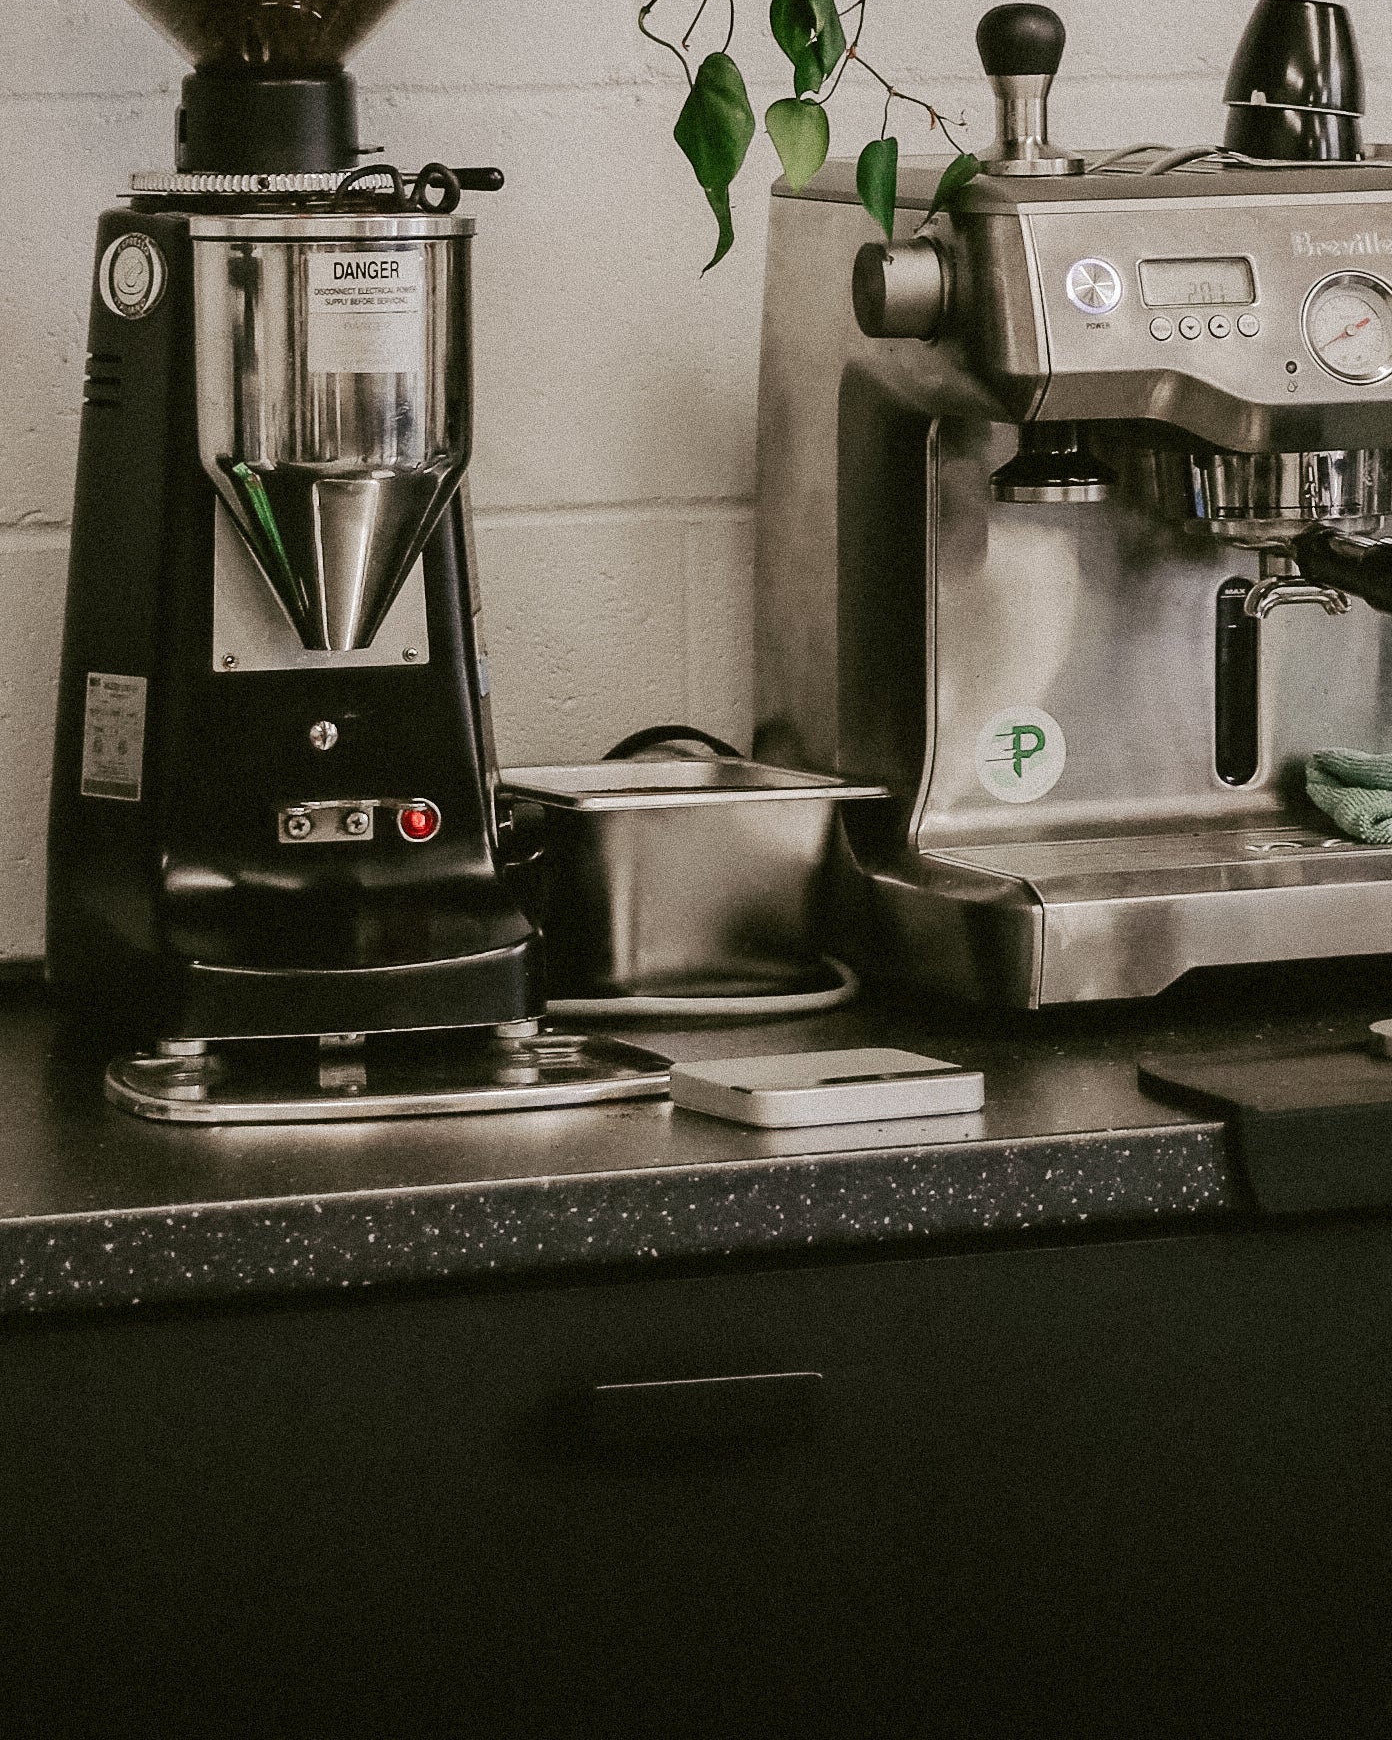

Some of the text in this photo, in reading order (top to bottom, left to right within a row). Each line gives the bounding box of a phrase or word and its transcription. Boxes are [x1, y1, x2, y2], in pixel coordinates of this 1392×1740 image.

[333, 260, 400, 280] DANGER
[314, 285, 417, 296] DISCONNECT ELECTRICAL POWER
[325, 298, 349, 306] SUPPLY
[350, 297, 376, 306] BEFORE
[1086, 322, 1111, 330] POWER
